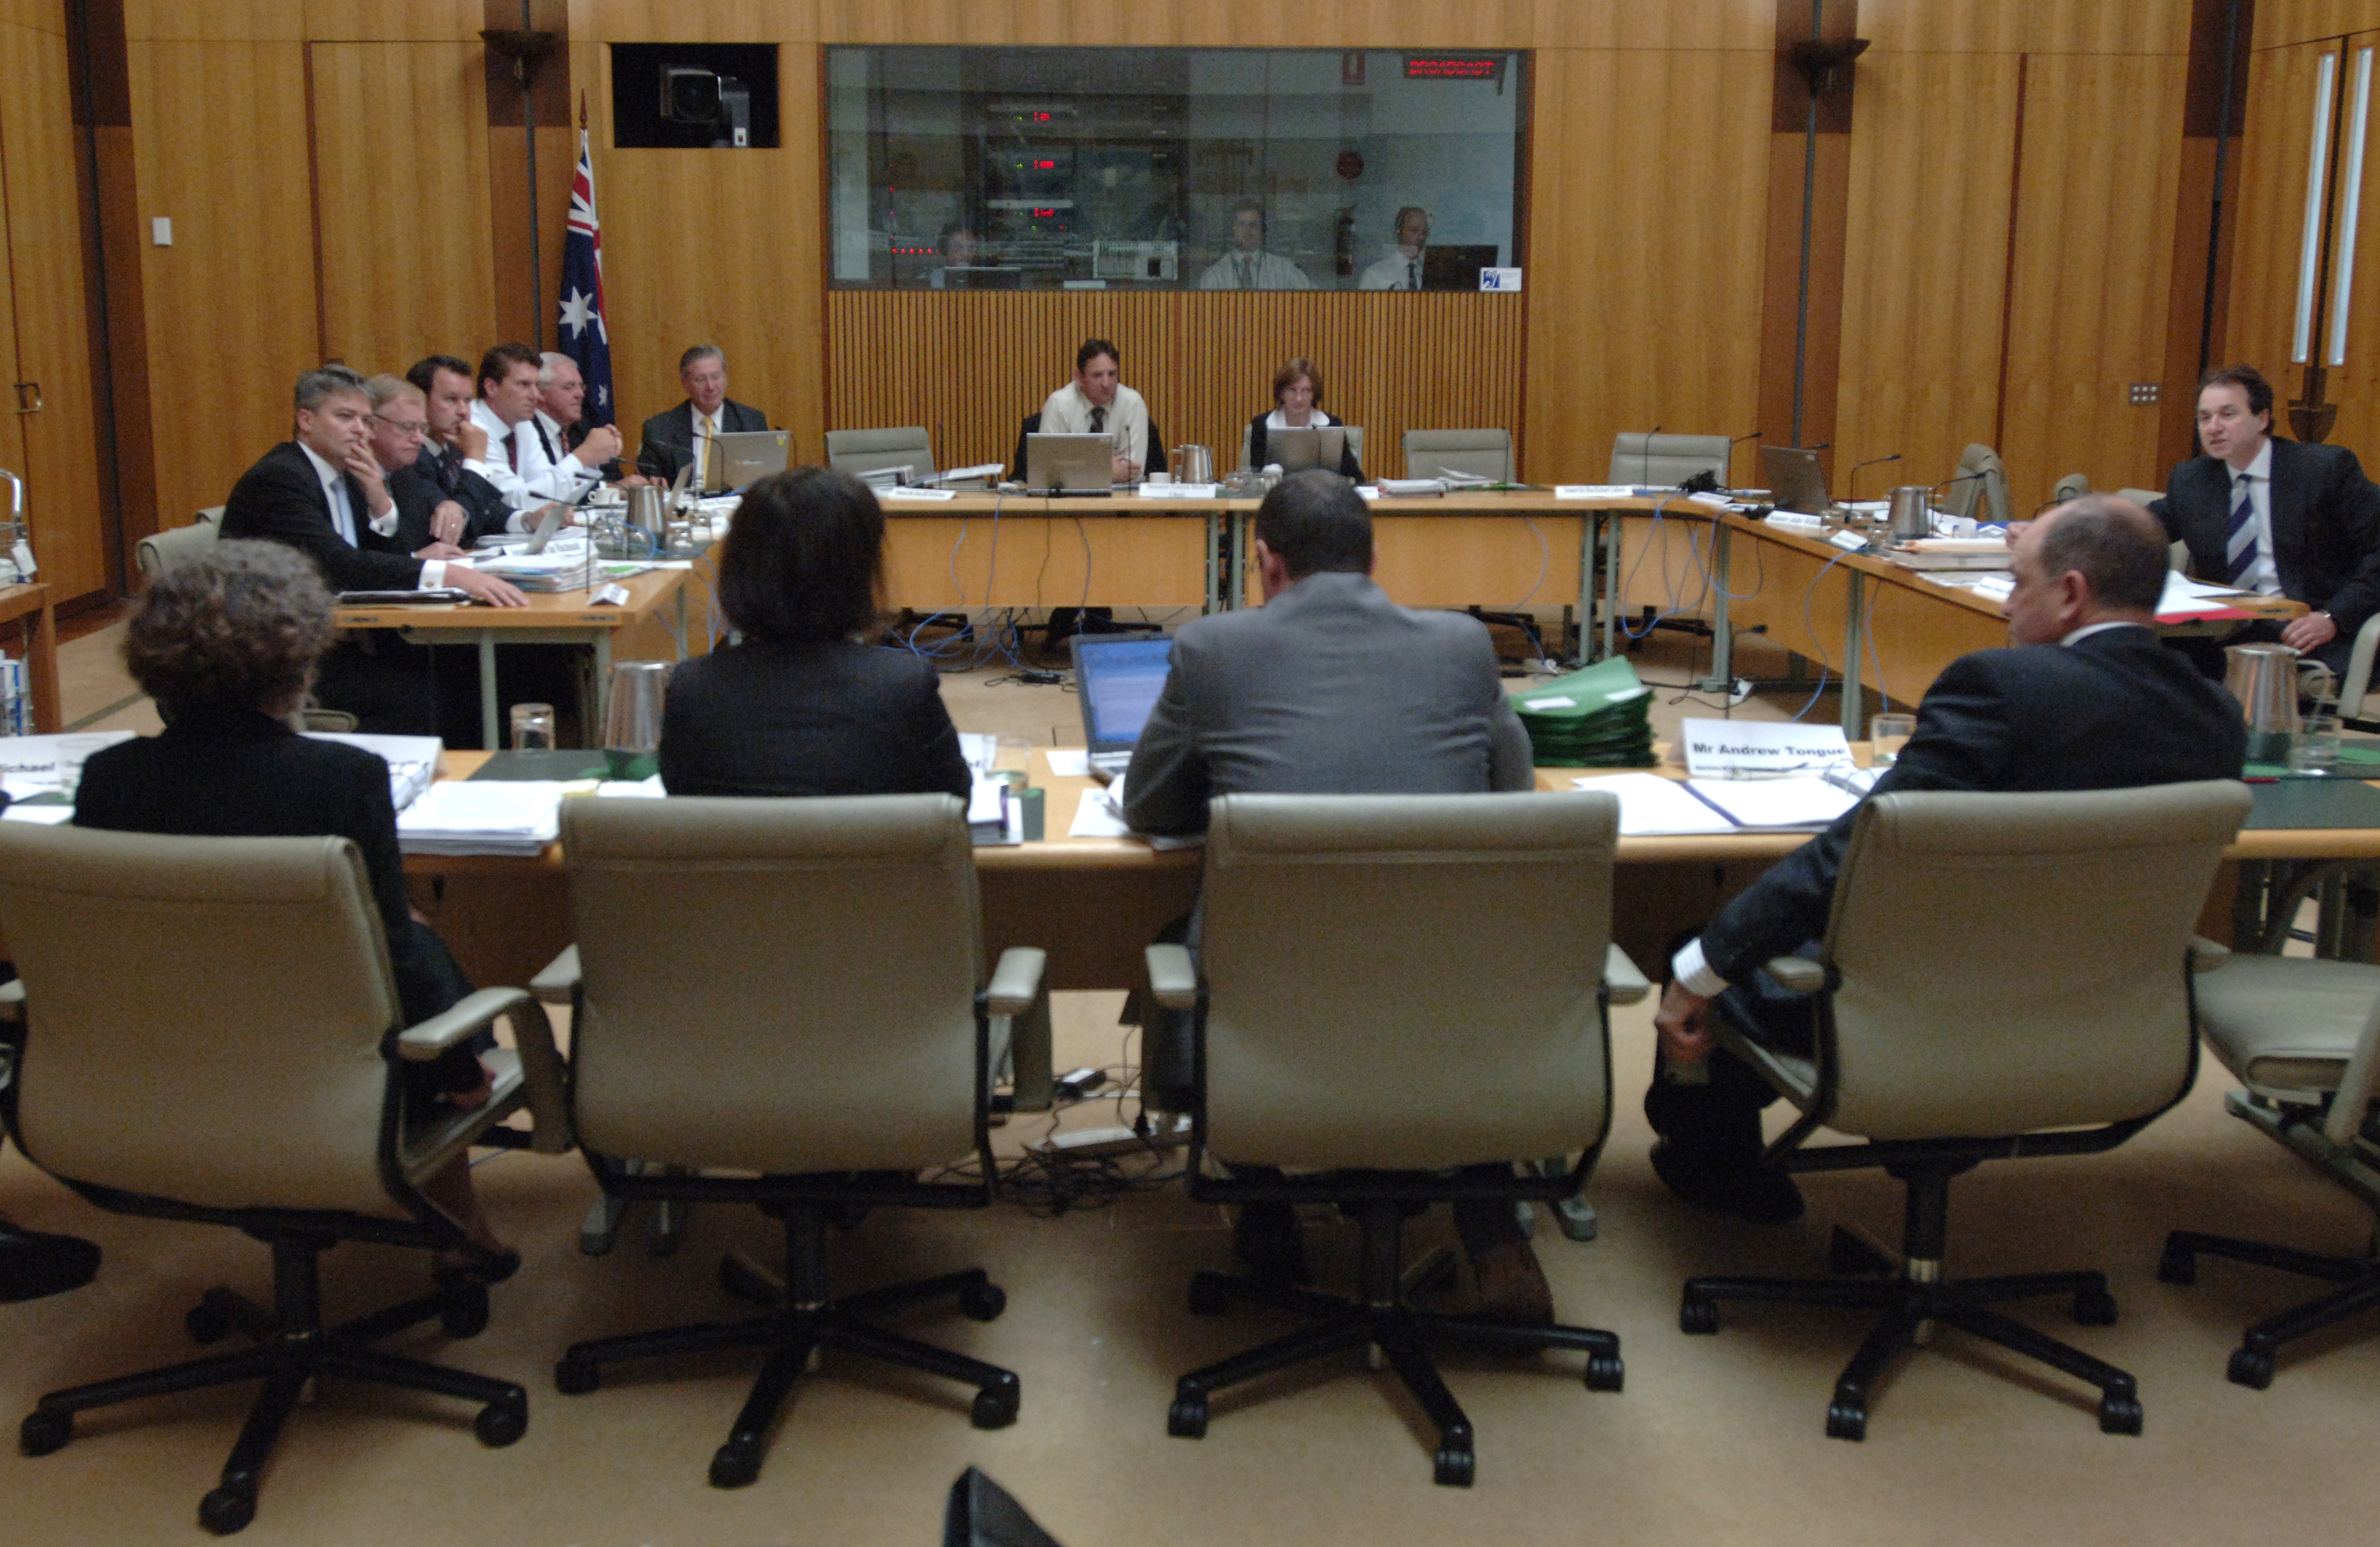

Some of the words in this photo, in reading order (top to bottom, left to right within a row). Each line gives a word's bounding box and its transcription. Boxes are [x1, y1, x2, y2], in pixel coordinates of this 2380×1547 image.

[1693, 743, 1713, 753] Mr
[1719, 744, 1780, 756] Andrew
[1784, 745, 1846, 758] Tongue
[0, 762, 56, 772] ichael
